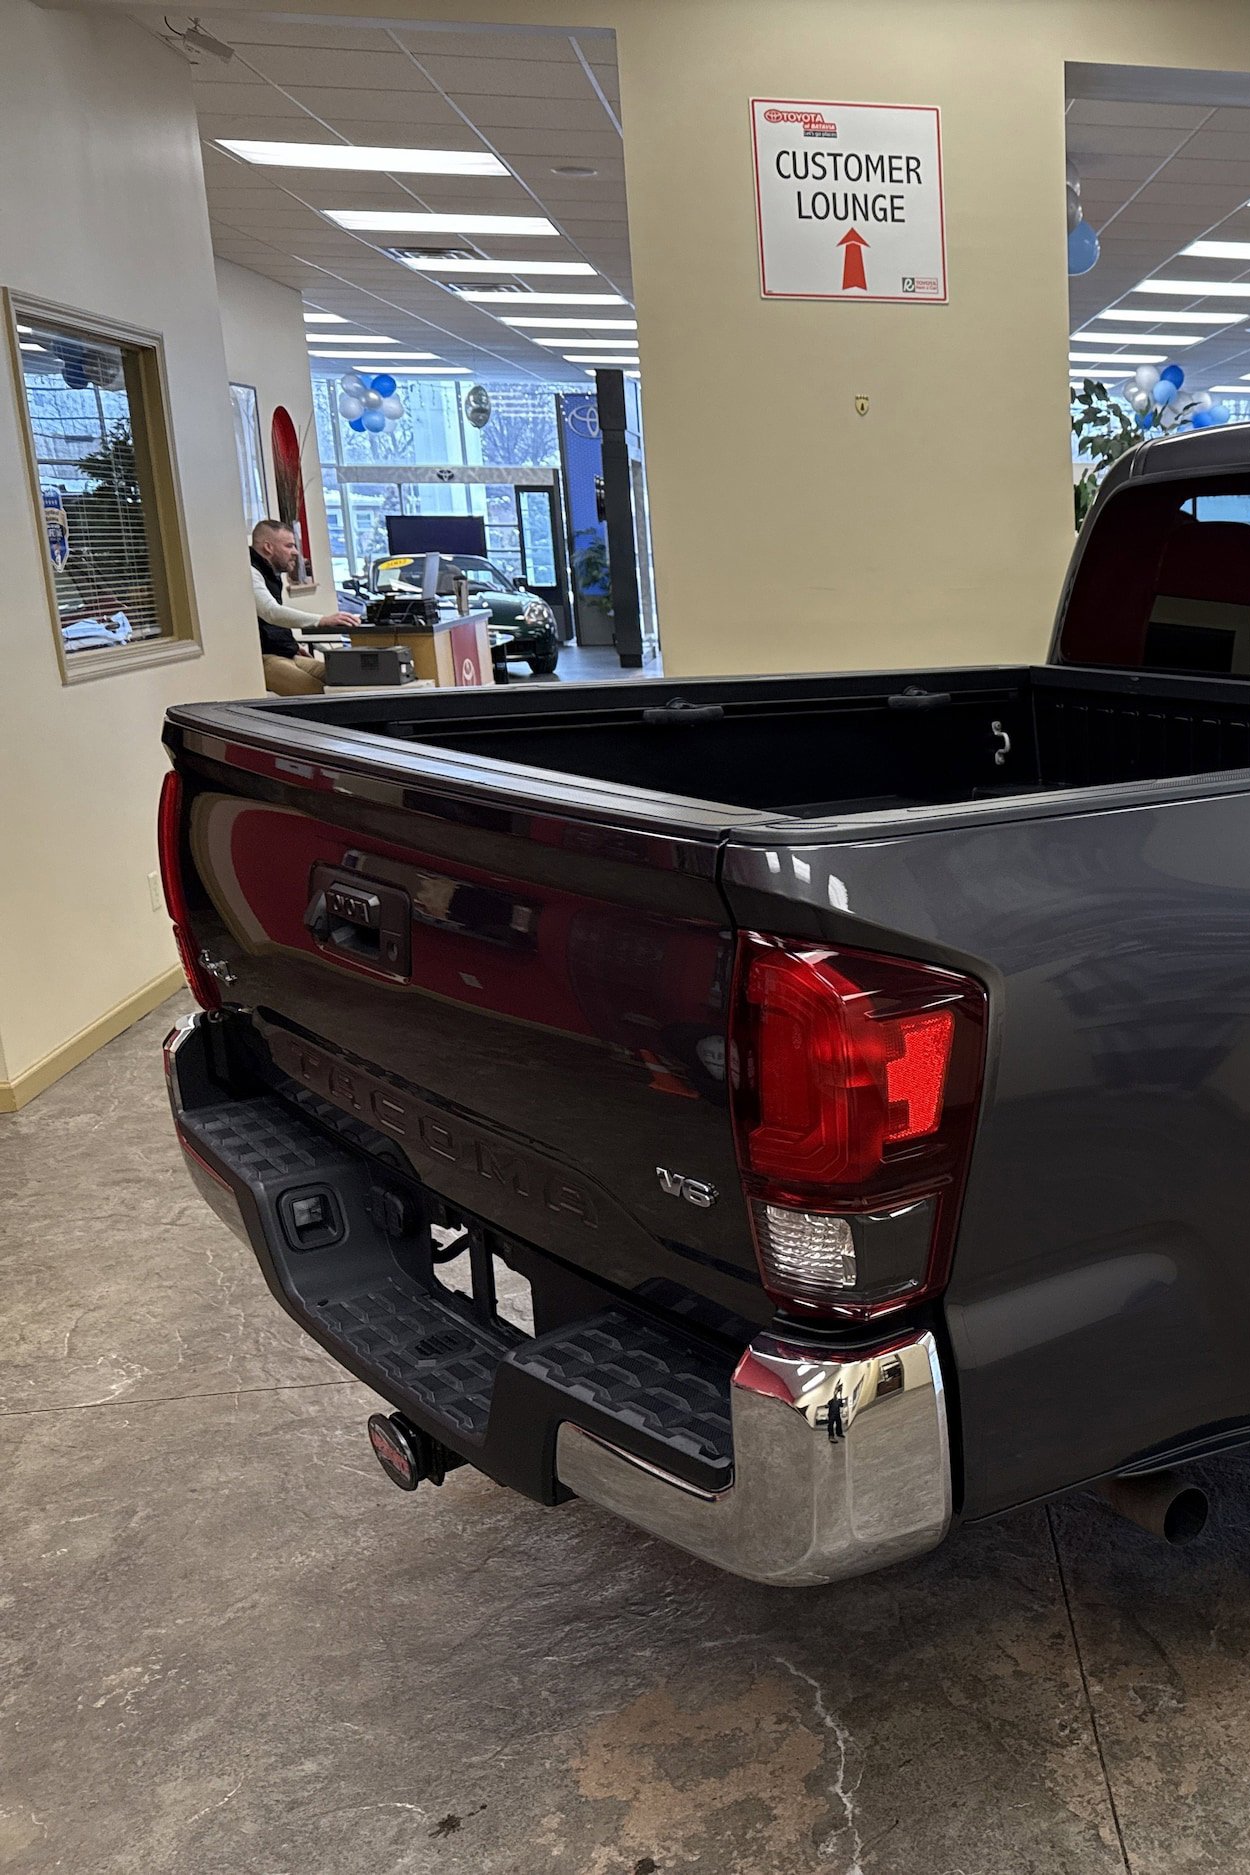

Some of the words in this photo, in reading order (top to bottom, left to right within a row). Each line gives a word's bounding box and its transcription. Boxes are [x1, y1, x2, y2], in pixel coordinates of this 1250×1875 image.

[781, 112, 824, 123] TOYOTA
[775, 149, 923, 185] CUSTOMER
[796, 190, 906, 223] LOUNGE
[293, 1046, 598, 1229] TACOMA
[655, 1166, 715, 1208] V6
